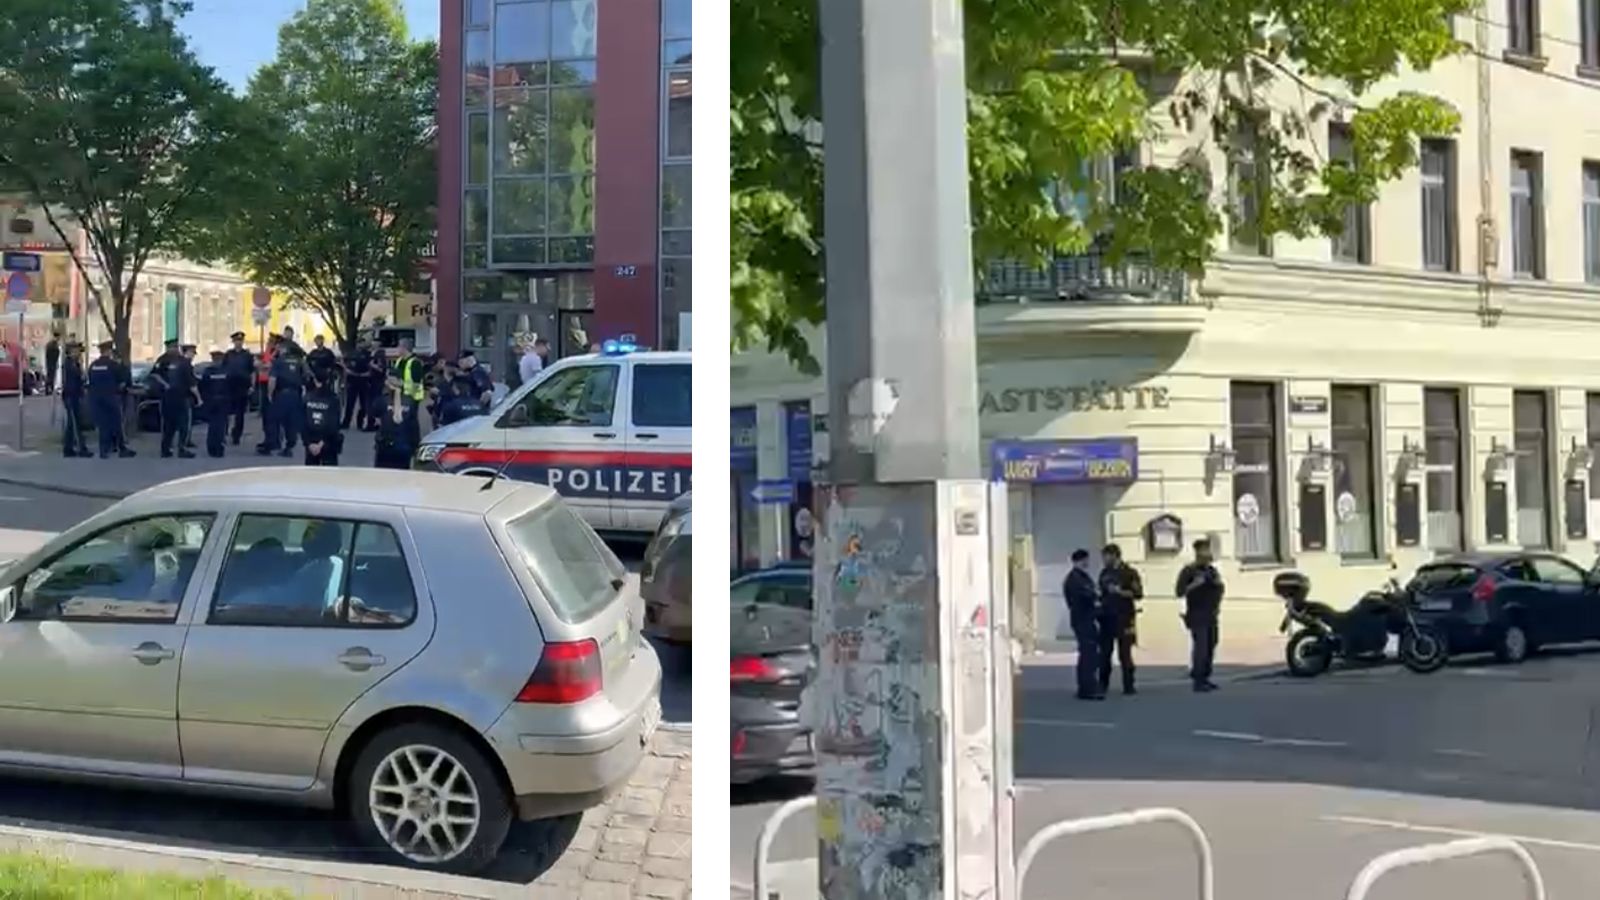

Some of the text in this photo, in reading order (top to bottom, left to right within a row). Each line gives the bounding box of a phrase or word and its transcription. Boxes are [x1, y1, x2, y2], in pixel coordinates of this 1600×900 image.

[616, 265, 636, 276] 247
[979, 379, 1170, 417] ASTSTÄTTE
[547, 468, 682, 494] POLIZEI
